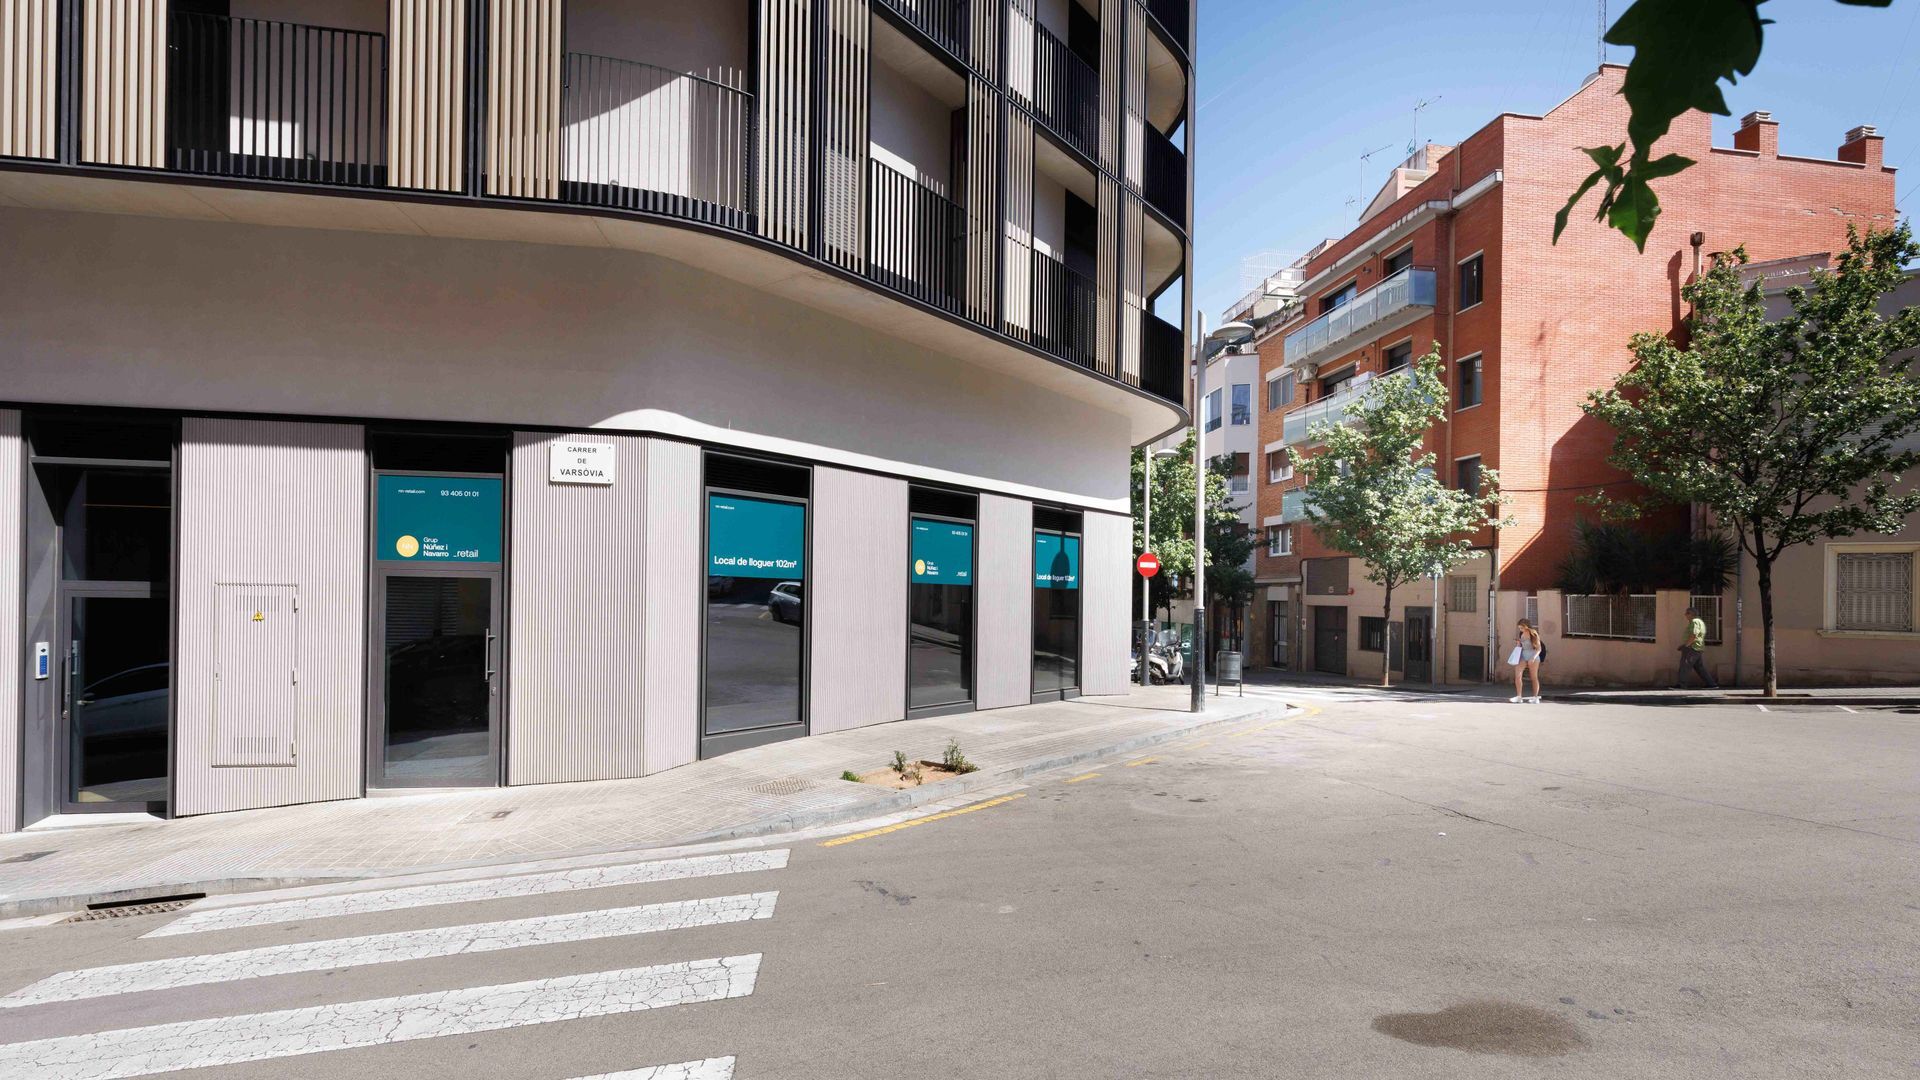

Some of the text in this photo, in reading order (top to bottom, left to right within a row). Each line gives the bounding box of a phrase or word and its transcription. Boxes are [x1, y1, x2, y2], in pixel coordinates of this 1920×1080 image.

[714, 556, 736, 565] Local
[737, 557, 747, 565] de
[749, 558, 774, 568] lloguer
